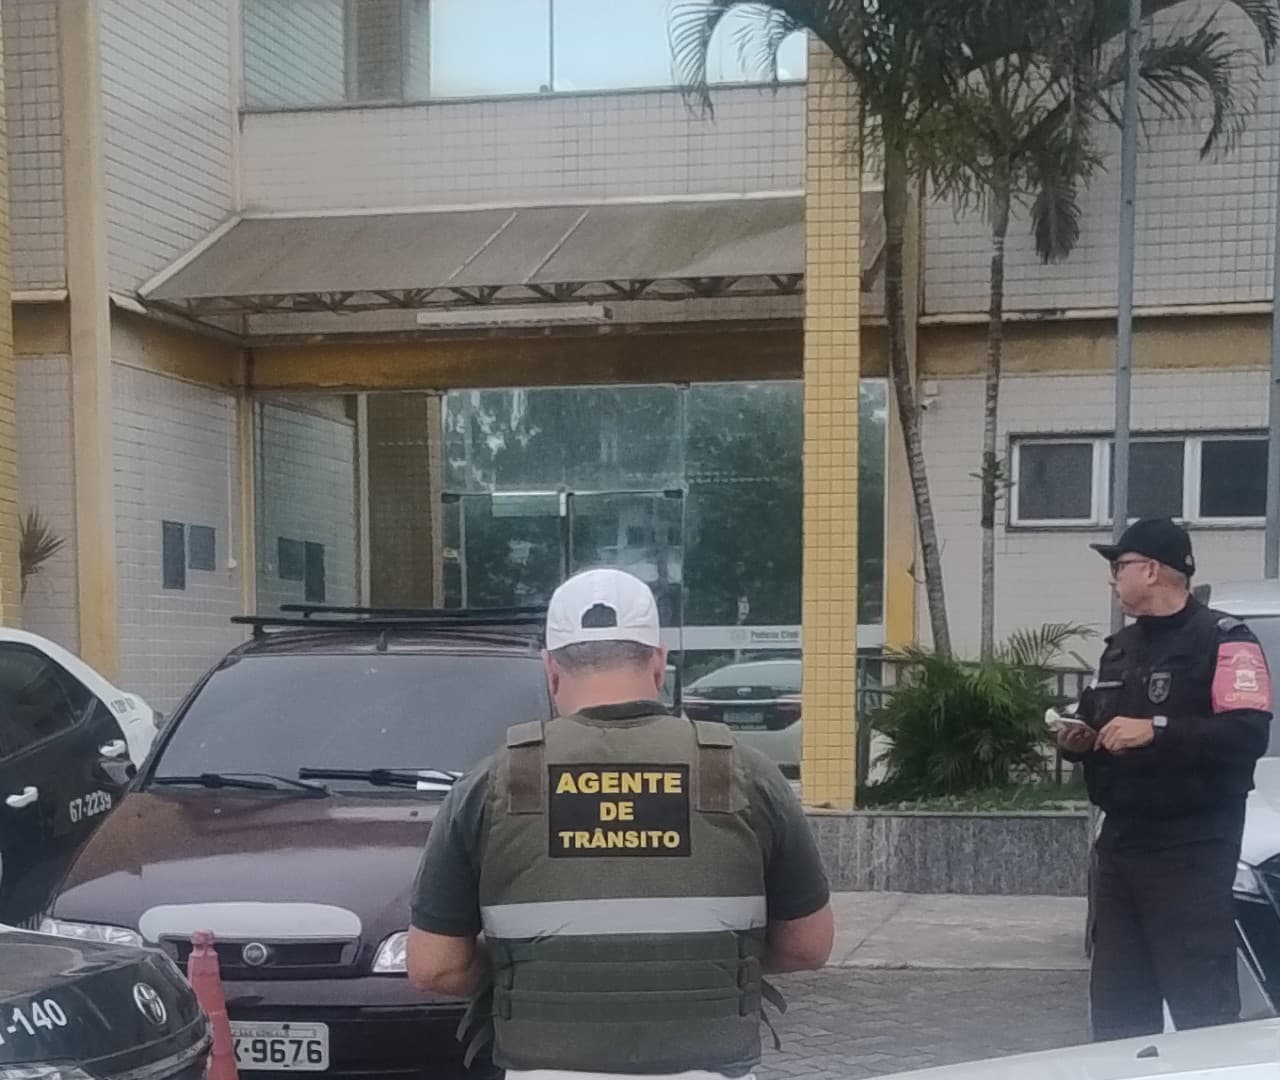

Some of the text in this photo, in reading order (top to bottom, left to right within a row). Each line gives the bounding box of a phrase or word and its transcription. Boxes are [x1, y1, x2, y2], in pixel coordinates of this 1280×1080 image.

[556, 771, 683, 794] AGENTE
[69, 789, 112, 823] 67-2239
[599, 801, 635, 822] DE
[558, 827, 681, 850] TRÂNSITO
